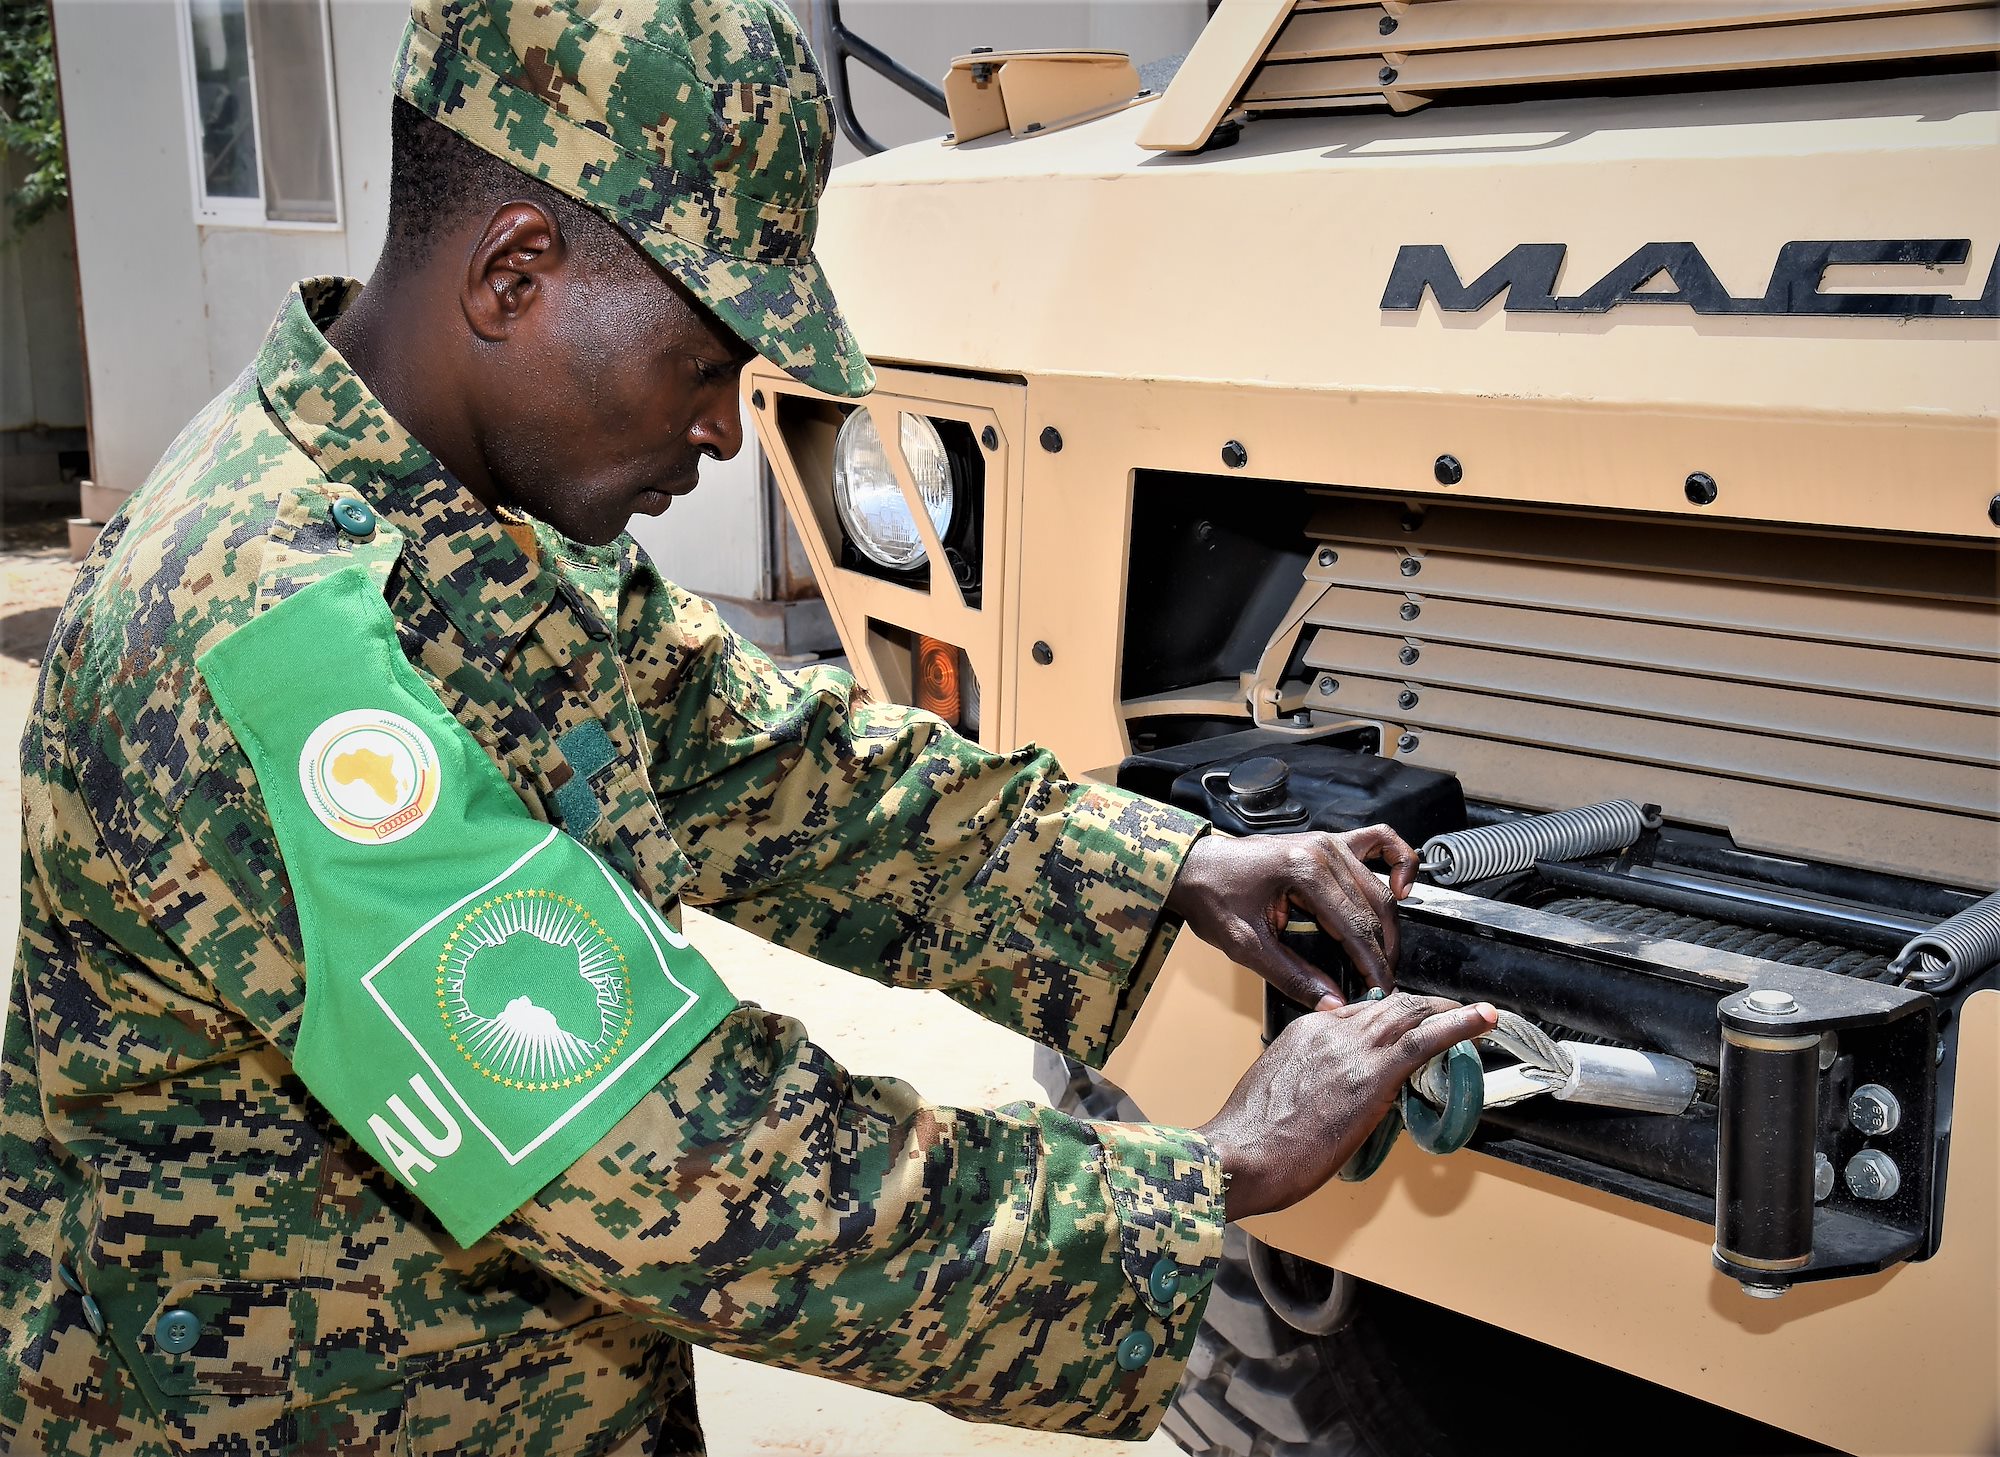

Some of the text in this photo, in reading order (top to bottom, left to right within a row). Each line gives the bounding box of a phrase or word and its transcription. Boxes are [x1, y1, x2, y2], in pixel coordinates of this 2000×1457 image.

[1380, 239, 2000, 317] MAC
[366, 1073, 463, 1187] AU
[1872, 1105, 1883, 1127] 8.8
